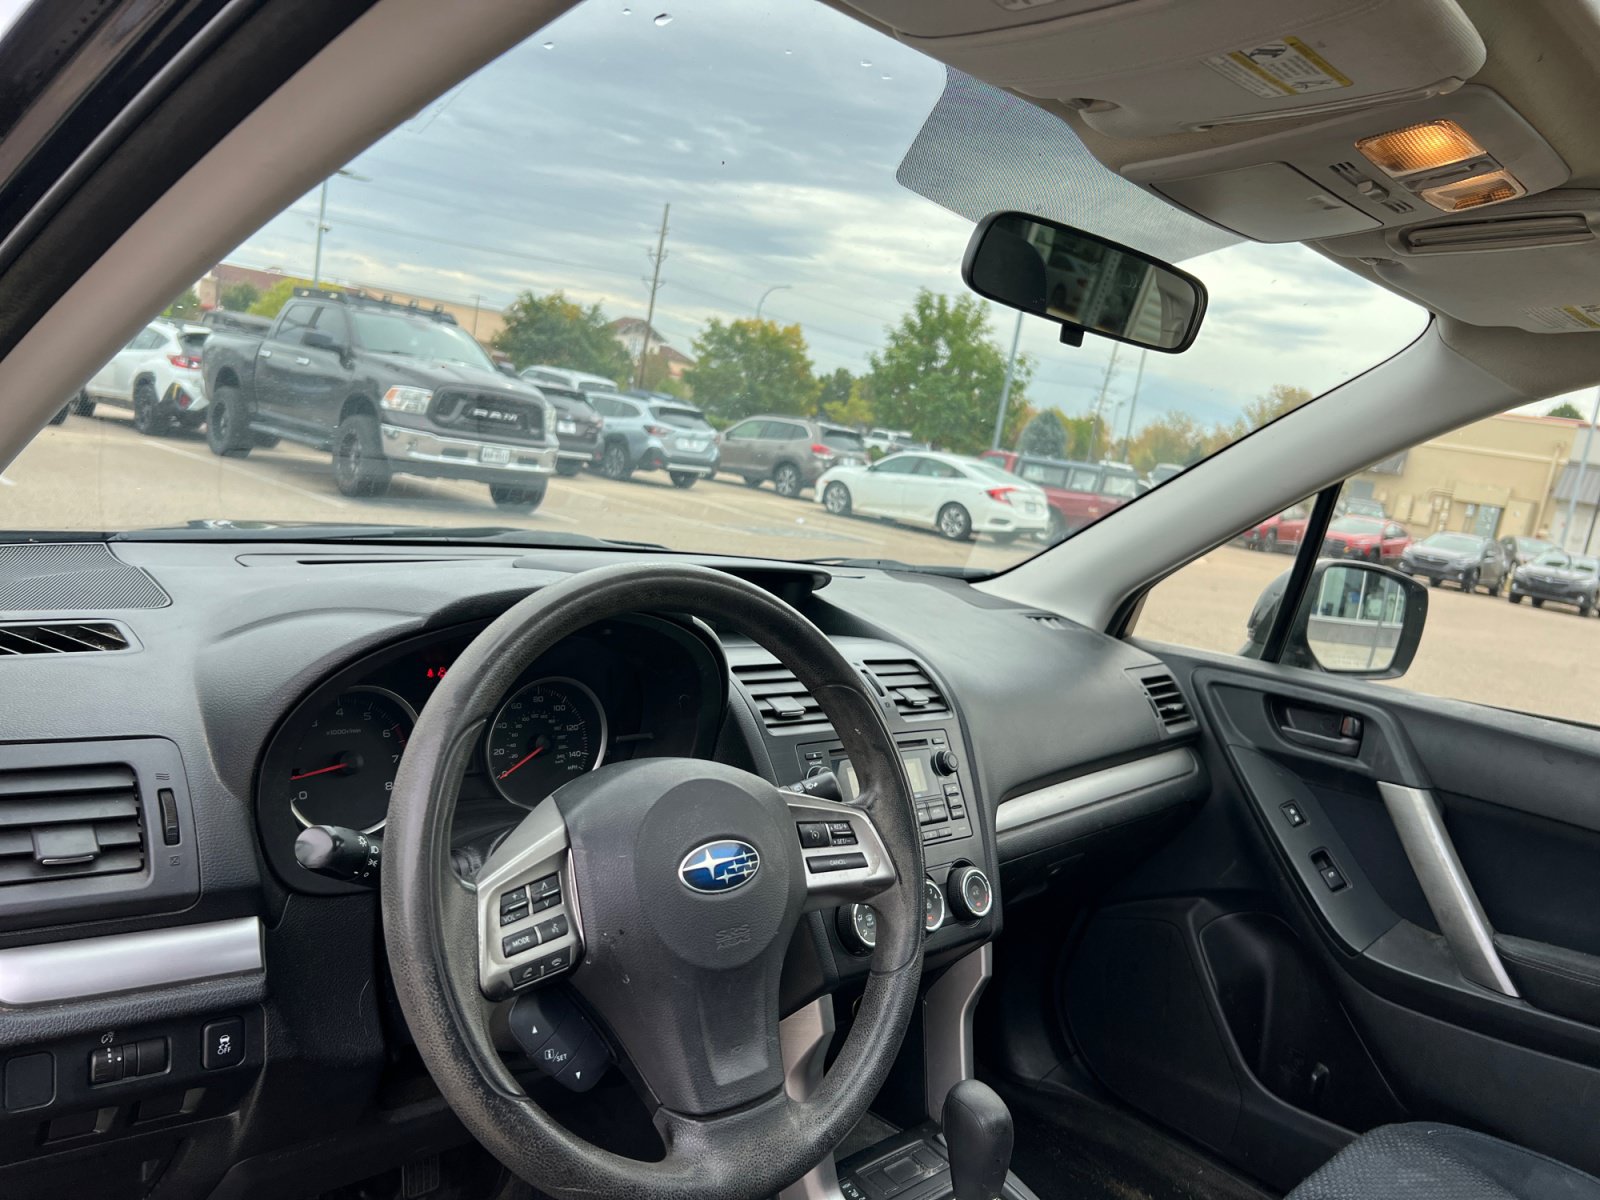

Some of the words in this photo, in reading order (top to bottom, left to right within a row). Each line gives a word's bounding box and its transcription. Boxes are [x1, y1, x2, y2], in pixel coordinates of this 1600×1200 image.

[336, 708, 344, 716] 4
[363, 712, 372, 721] 5
[382, 729, 391, 738] 6
[392, 754, 399, 763] 7
[384, 781, 393, 791] 8
[298, 791, 307, 800] 0
[512, 935, 530, 947] MODE
